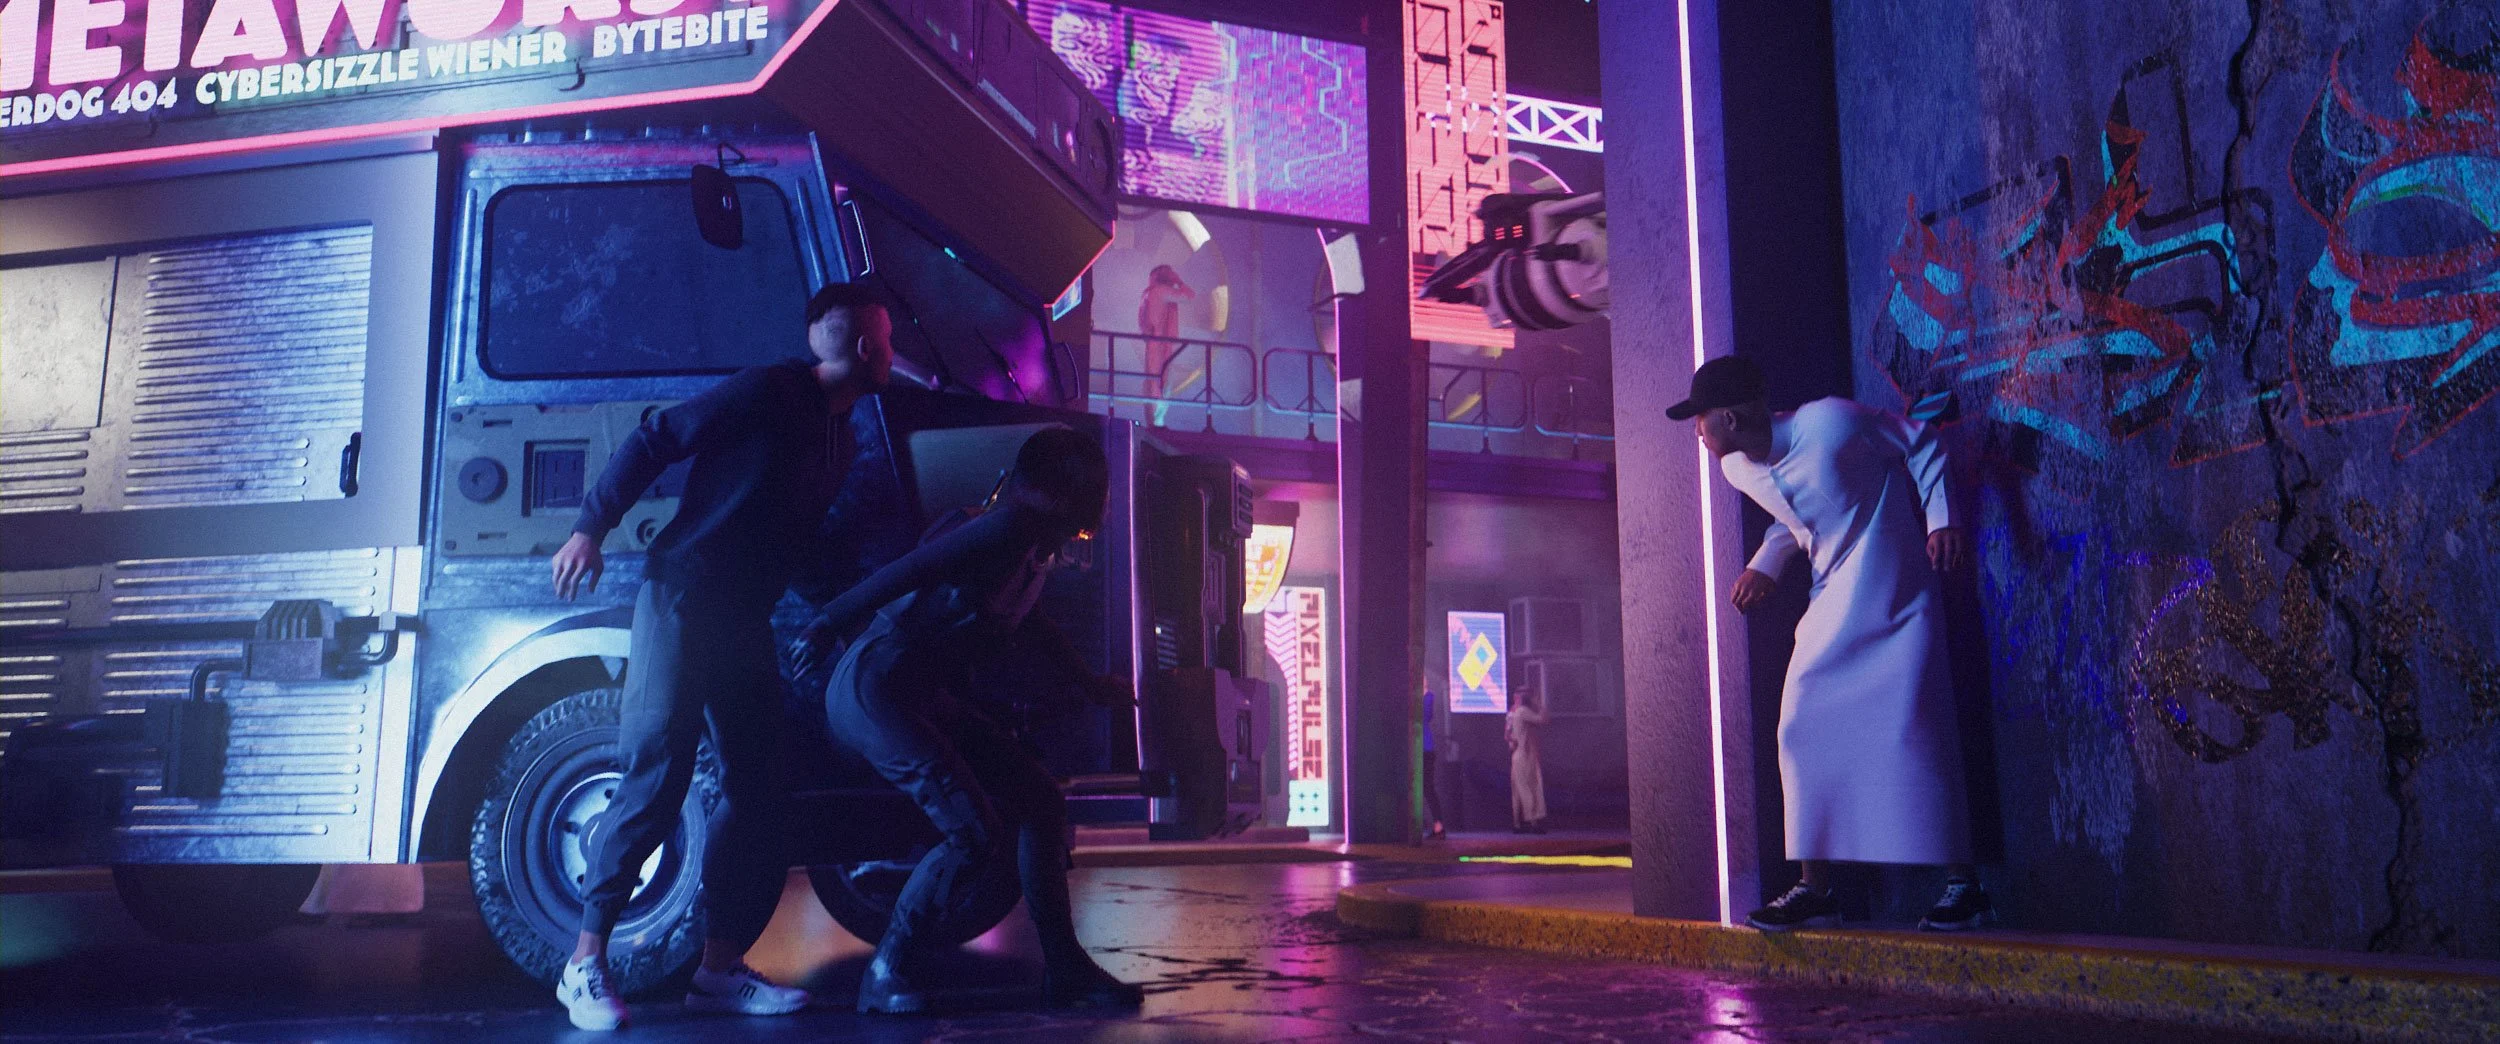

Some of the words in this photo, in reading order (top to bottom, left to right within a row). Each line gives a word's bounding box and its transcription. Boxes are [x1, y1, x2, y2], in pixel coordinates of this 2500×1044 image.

[110, 77, 178, 114] 404
[195, 49, 419, 104] CYBERSIZZLE
[427, 31, 567, 78] WIENER
[592, 6, 768, 58] BYTEBITE
[1299, 592, 1323, 779] PIXELPULSE
